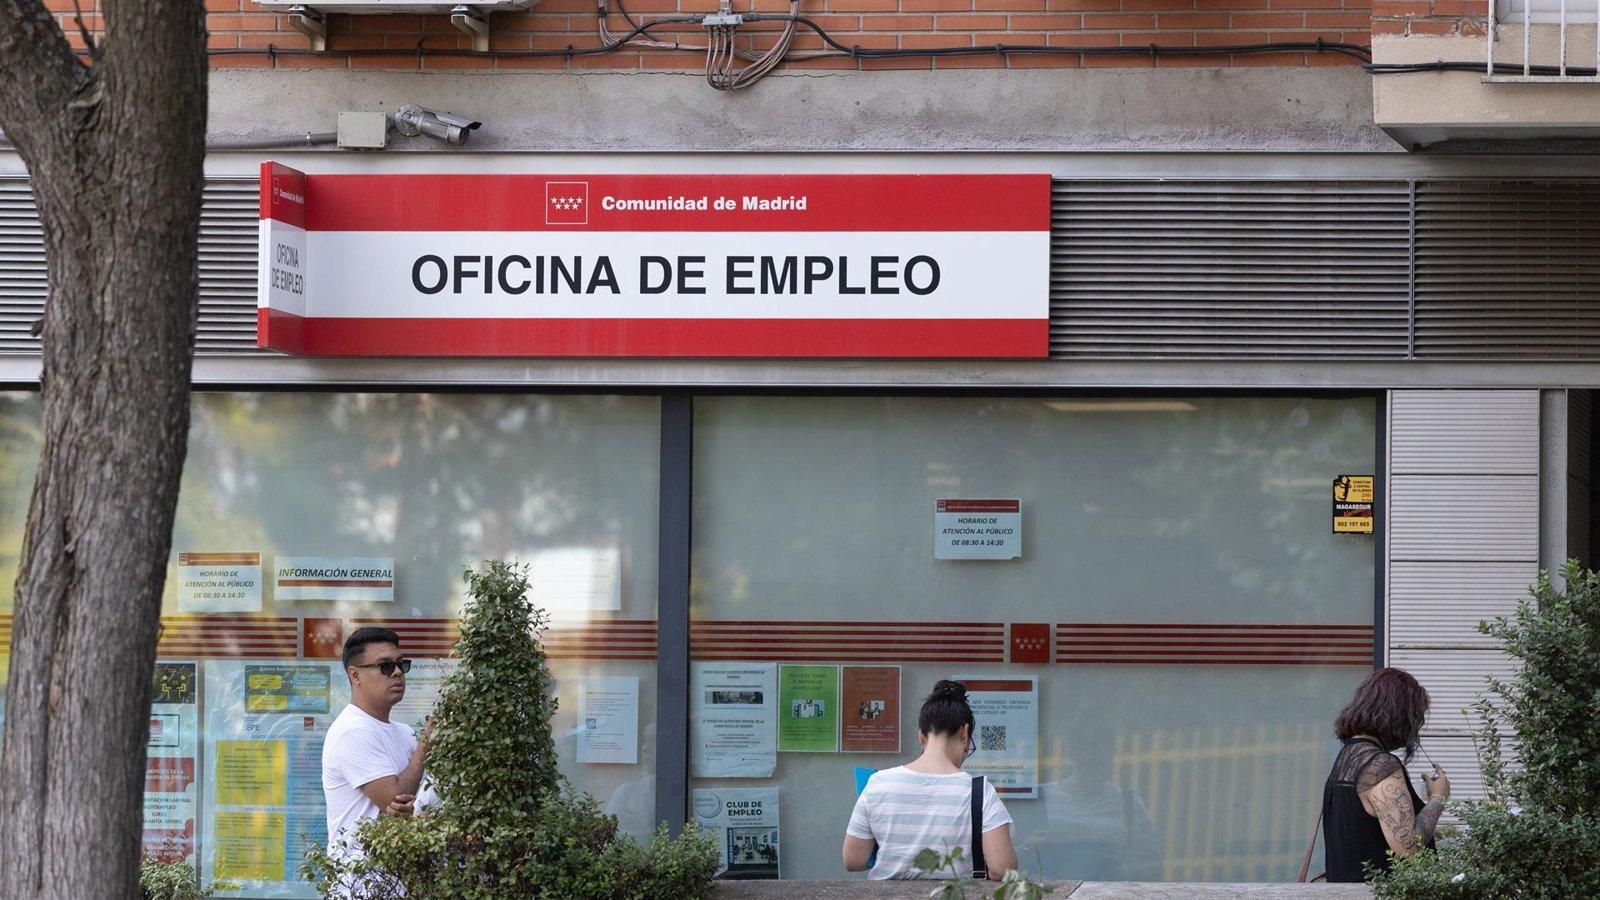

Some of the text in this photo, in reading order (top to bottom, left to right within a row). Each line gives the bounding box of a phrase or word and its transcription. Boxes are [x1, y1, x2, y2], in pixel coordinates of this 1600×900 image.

[601, 195, 807, 211] Comunidad de Madrid
[276, 243, 299, 268] OFICINA
[271, 268, 304, 295] DE EMPLEO
[411, 254, 941, 296] OFICINA DE EMPLEO
[279, 567, 392, 578] INFORMACIÓN GENERAL
